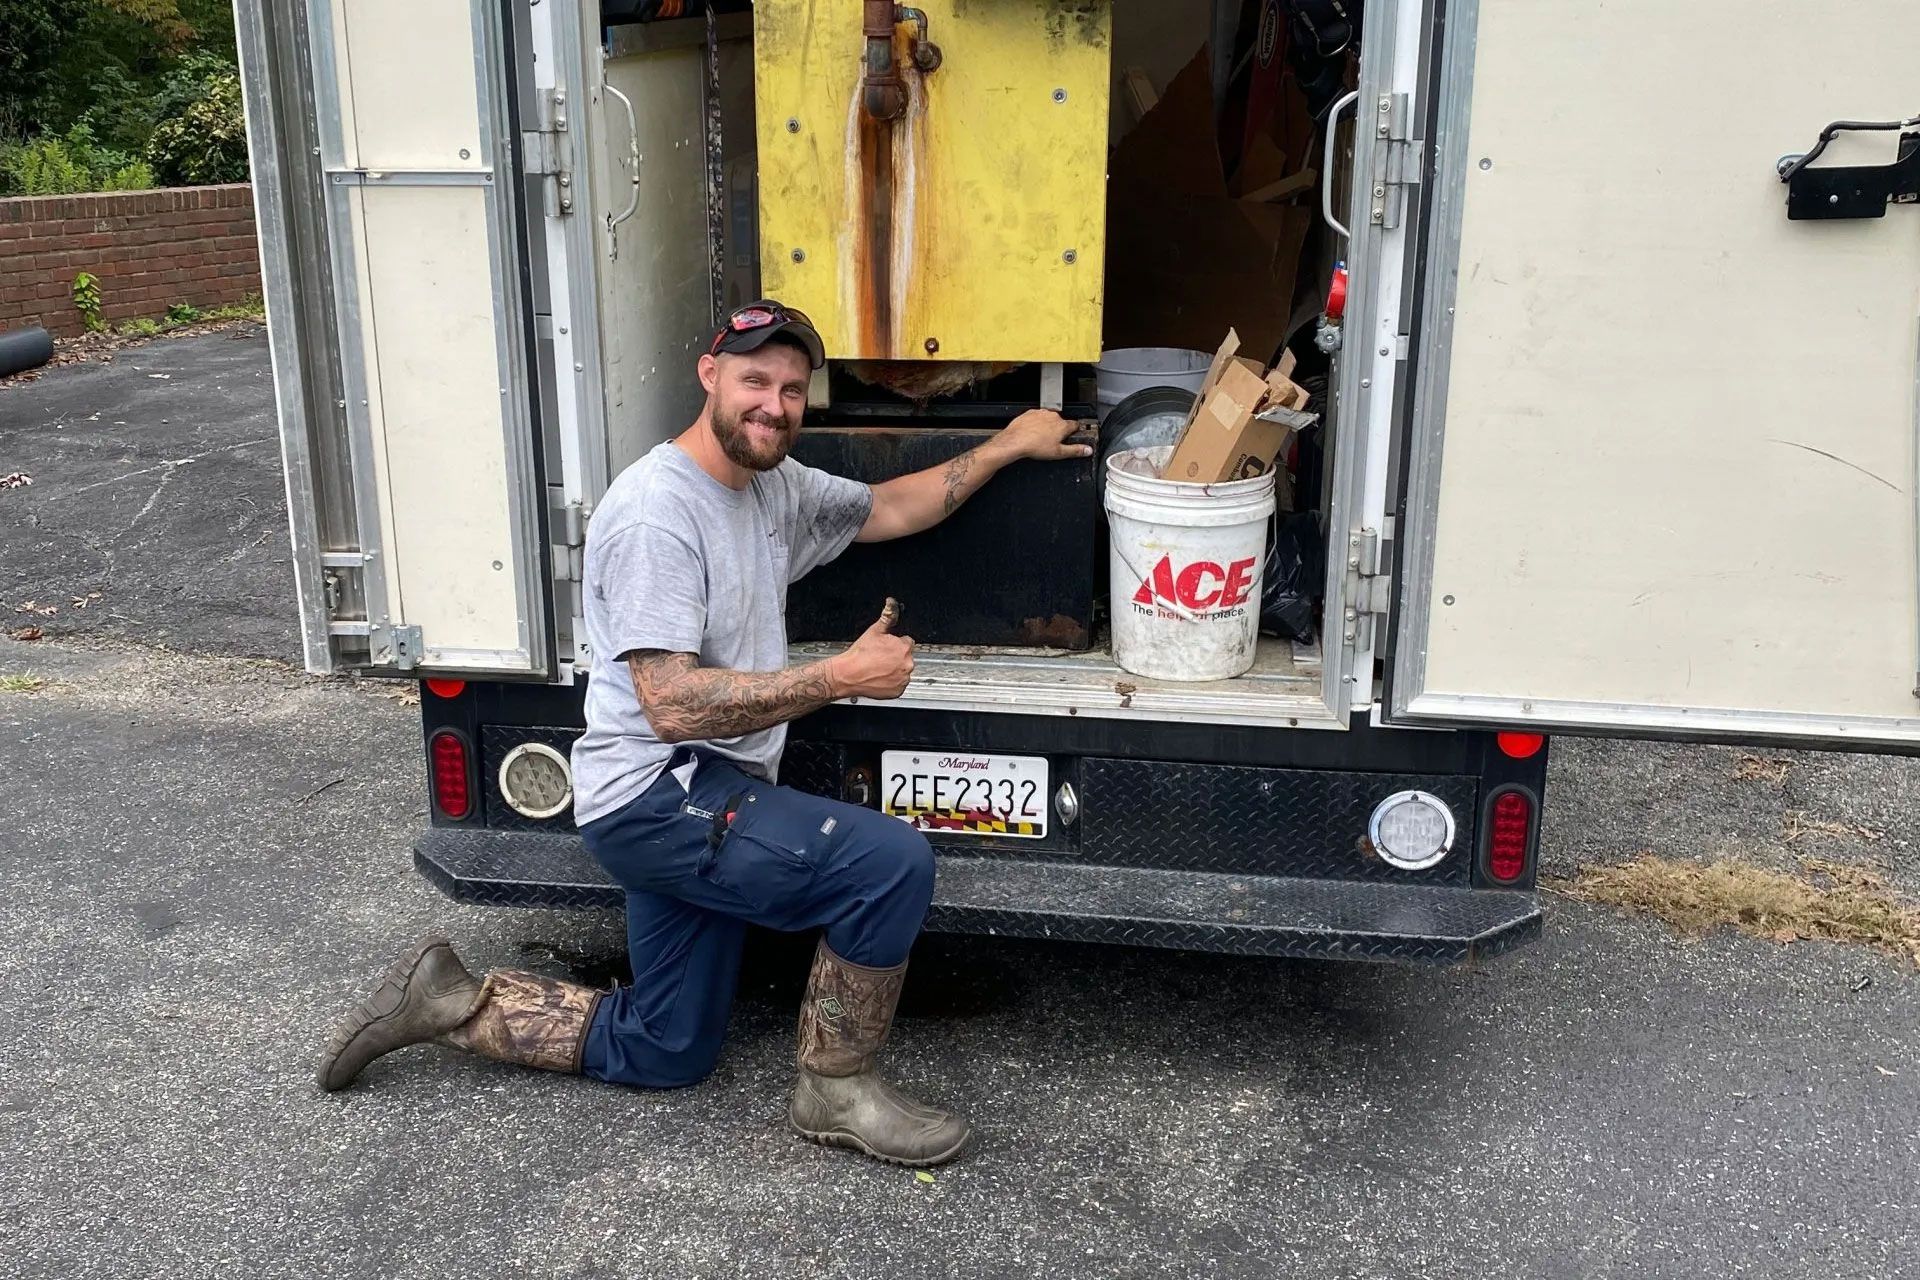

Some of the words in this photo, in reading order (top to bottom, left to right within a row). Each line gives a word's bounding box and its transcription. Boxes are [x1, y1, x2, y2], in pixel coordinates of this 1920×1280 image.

[1263, 12, 1275, 54] WERNER
[1133, 554, 1256, 609] ACE
[1132, 603, 1153, 617] The
[938, 757, 991, 772] Maryland
[890, 773, 1038, 817] 2EE2332
